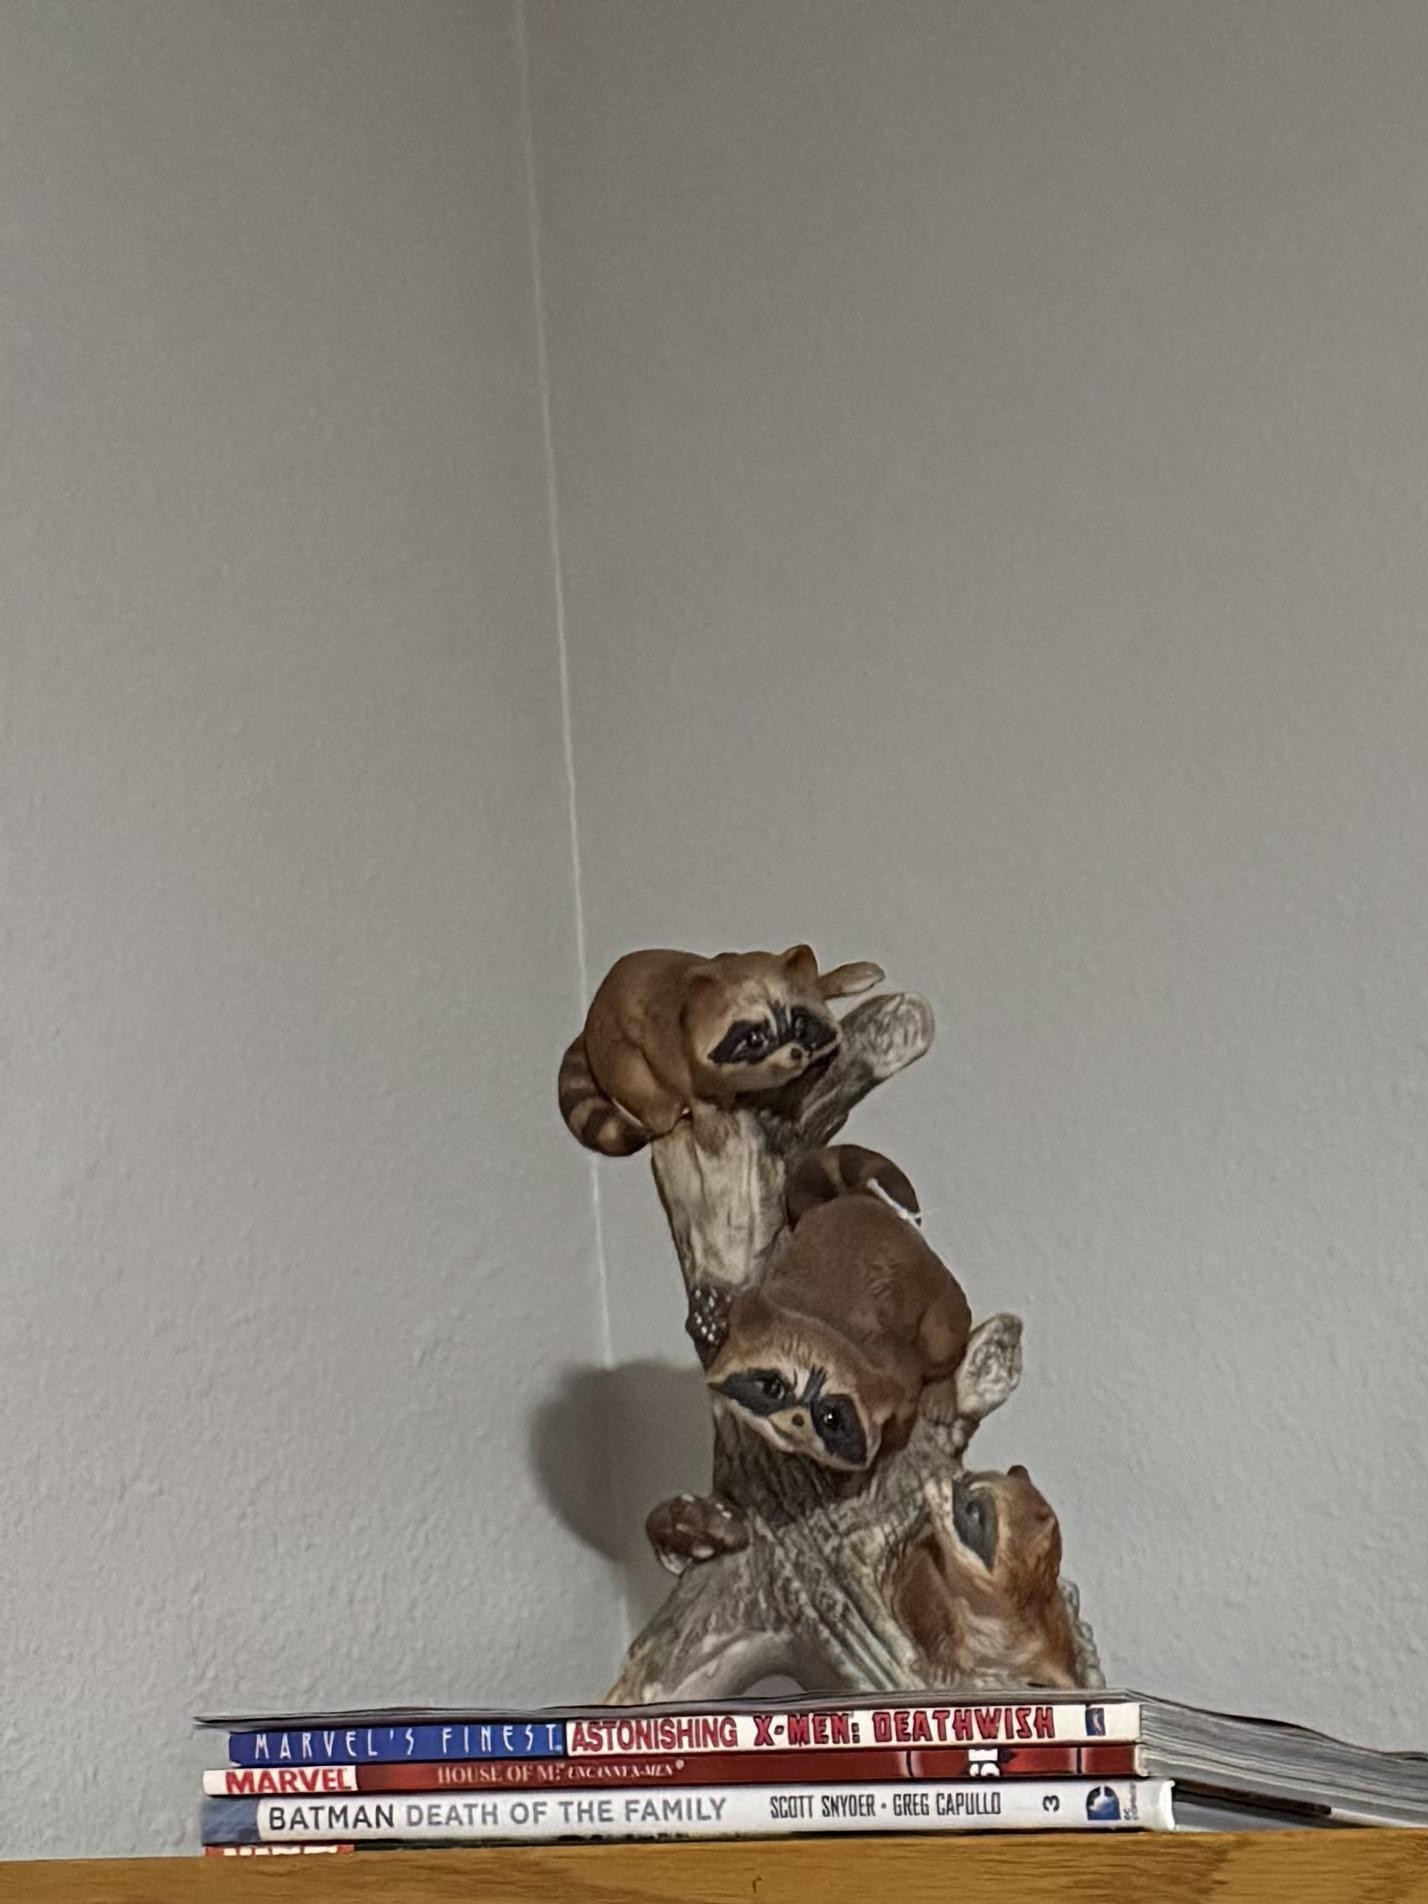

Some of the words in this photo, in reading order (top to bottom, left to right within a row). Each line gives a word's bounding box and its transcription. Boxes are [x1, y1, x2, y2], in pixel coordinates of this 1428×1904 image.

[254, 1731, 414, 1760] MARVEL'S
[442, 1724, 559, 1754] FINEST
[570, 1715, 739, 1753] ASTONISHING
[753, 1711, 860, 1747] X-MEN:
[873, 1707, 1056, 1743] DEATHWISH
[224, 1768, 352, 1795] MARVEL
[268, 1804, 395, 1832] BATMAN
[406, 1801, 499, 1828] DEATH
[509, 1801, 548, 1825] OF
[558, 1800, 613, 1823] THE
[623, 1798, 727, 1822] FAMILY
[769, 1794, 815, 1820] SCOTT
[821, 1794, 875, 1818] SNYDER
[892, 1792, 930, 1817] GREG
[935, 1792, 1001, 1816] CAPULLO
